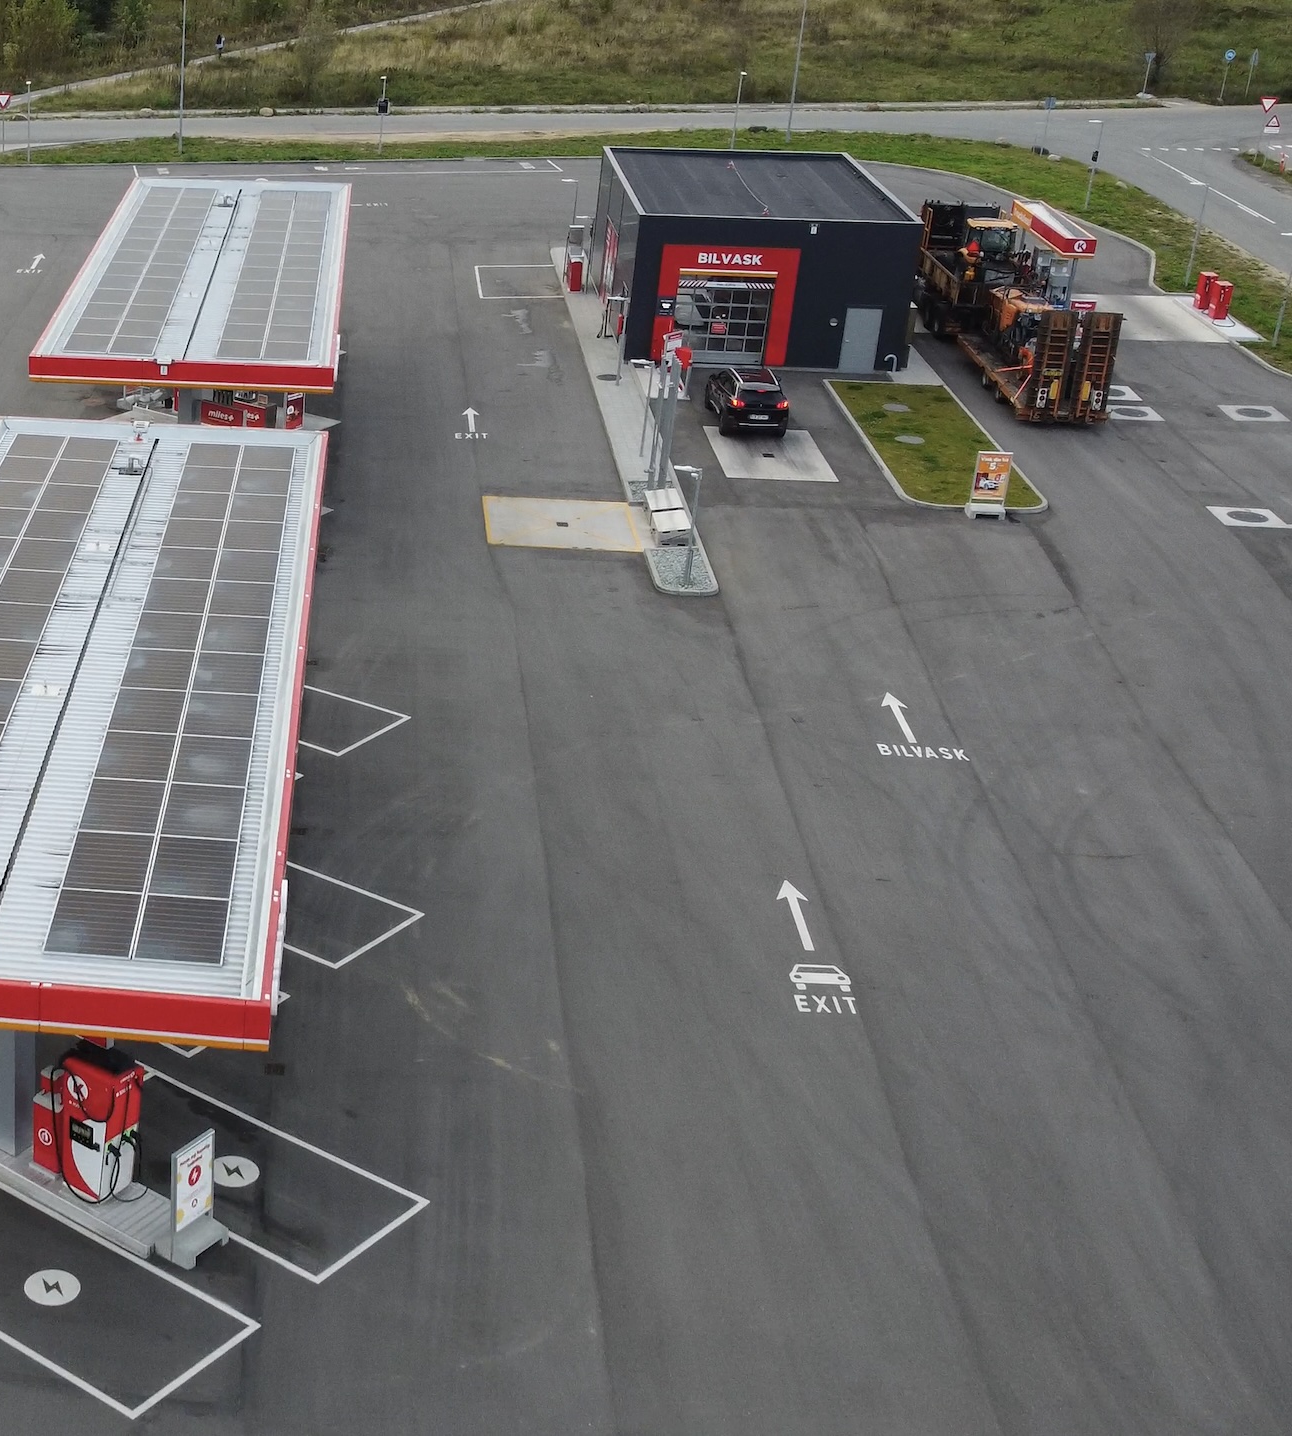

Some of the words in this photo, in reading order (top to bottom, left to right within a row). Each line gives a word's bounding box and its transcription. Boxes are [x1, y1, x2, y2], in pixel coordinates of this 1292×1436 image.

[697, 252, 763, 266] BILVASK
[454, 432, 488, 440] EXIT
[876, 743, 970, 762] BILVASK
[794, 994, 857, 1014] EXIT
